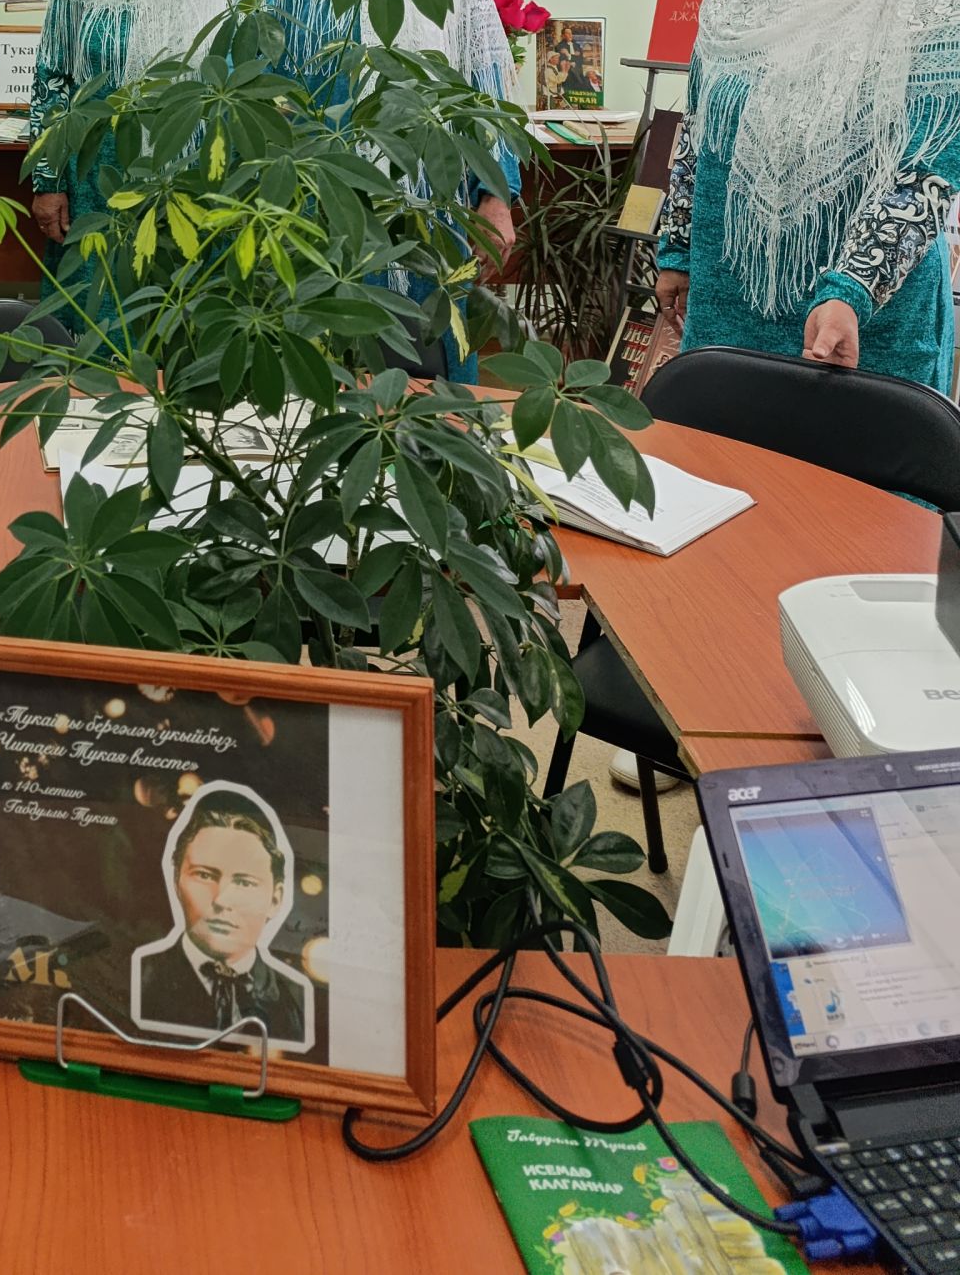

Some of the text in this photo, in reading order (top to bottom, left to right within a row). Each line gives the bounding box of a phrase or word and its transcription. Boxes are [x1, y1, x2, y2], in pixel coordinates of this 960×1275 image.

[1, 44, 41, 58] Тука
[11, 67, 36, 75] әки
[68, 741, 130, 767] Тукая
[130, 747, 200, 771] вместе»
[728, 786, 761, 802] acer
[3, 799, 118, 828] Габдуллы Тукая
[528, 1179, 623, 1195] КАЛГАННАР
